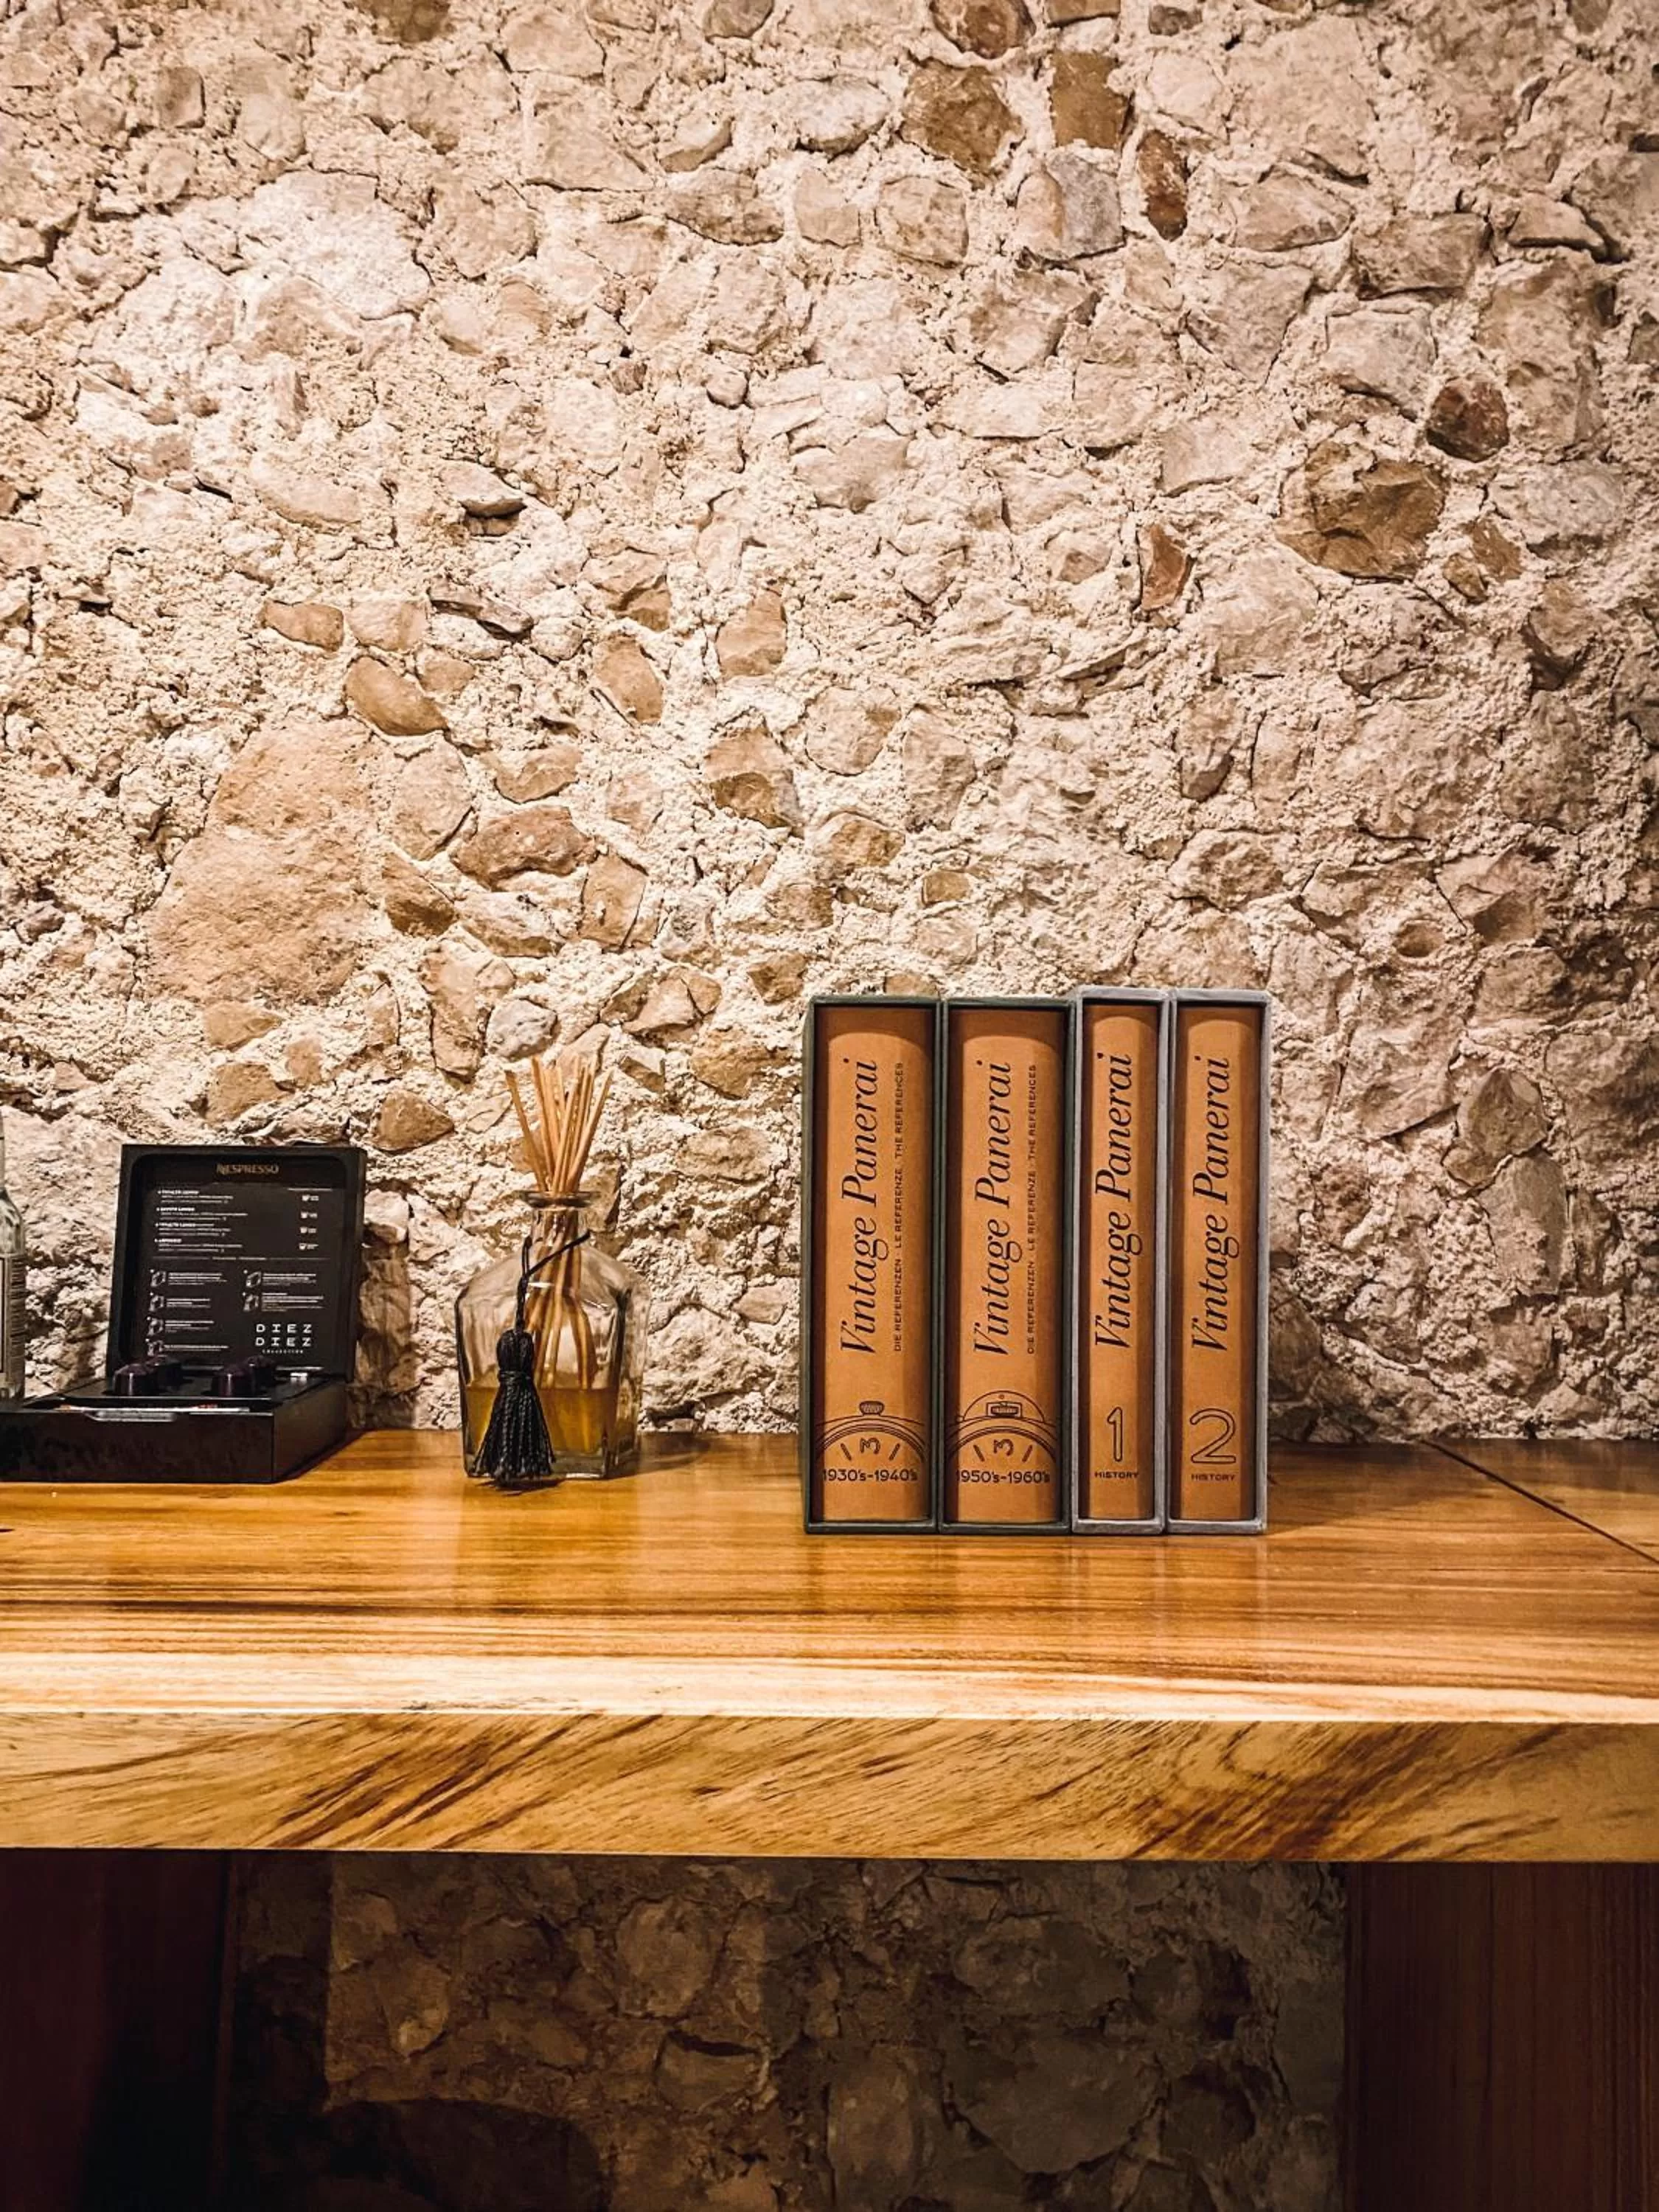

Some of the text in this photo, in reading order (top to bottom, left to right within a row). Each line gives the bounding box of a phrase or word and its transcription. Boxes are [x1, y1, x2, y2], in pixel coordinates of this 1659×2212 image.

[217, 1164, 279, 1175] NESPRESSO
[841, 1057, 889, 1354] Vintage Panerai
[894, 1062, 903, 1352] DIE REFERENZEN LE REFERENZE THE REFERENCES
[973, 1060, 1023, 1355] Vintage Panerai
[1028, 1139, 1036, 1160] THE
[1094, 1052, 1143, 1349] Vintage Panerai
[1192, 1055, 1239, 1352] Vintage Panerai
[1027, 1238, 1035, 1251] LE
[1107, 1407, 1123, 1462] 1
[1189, 1408, 1237, 1464] 2
